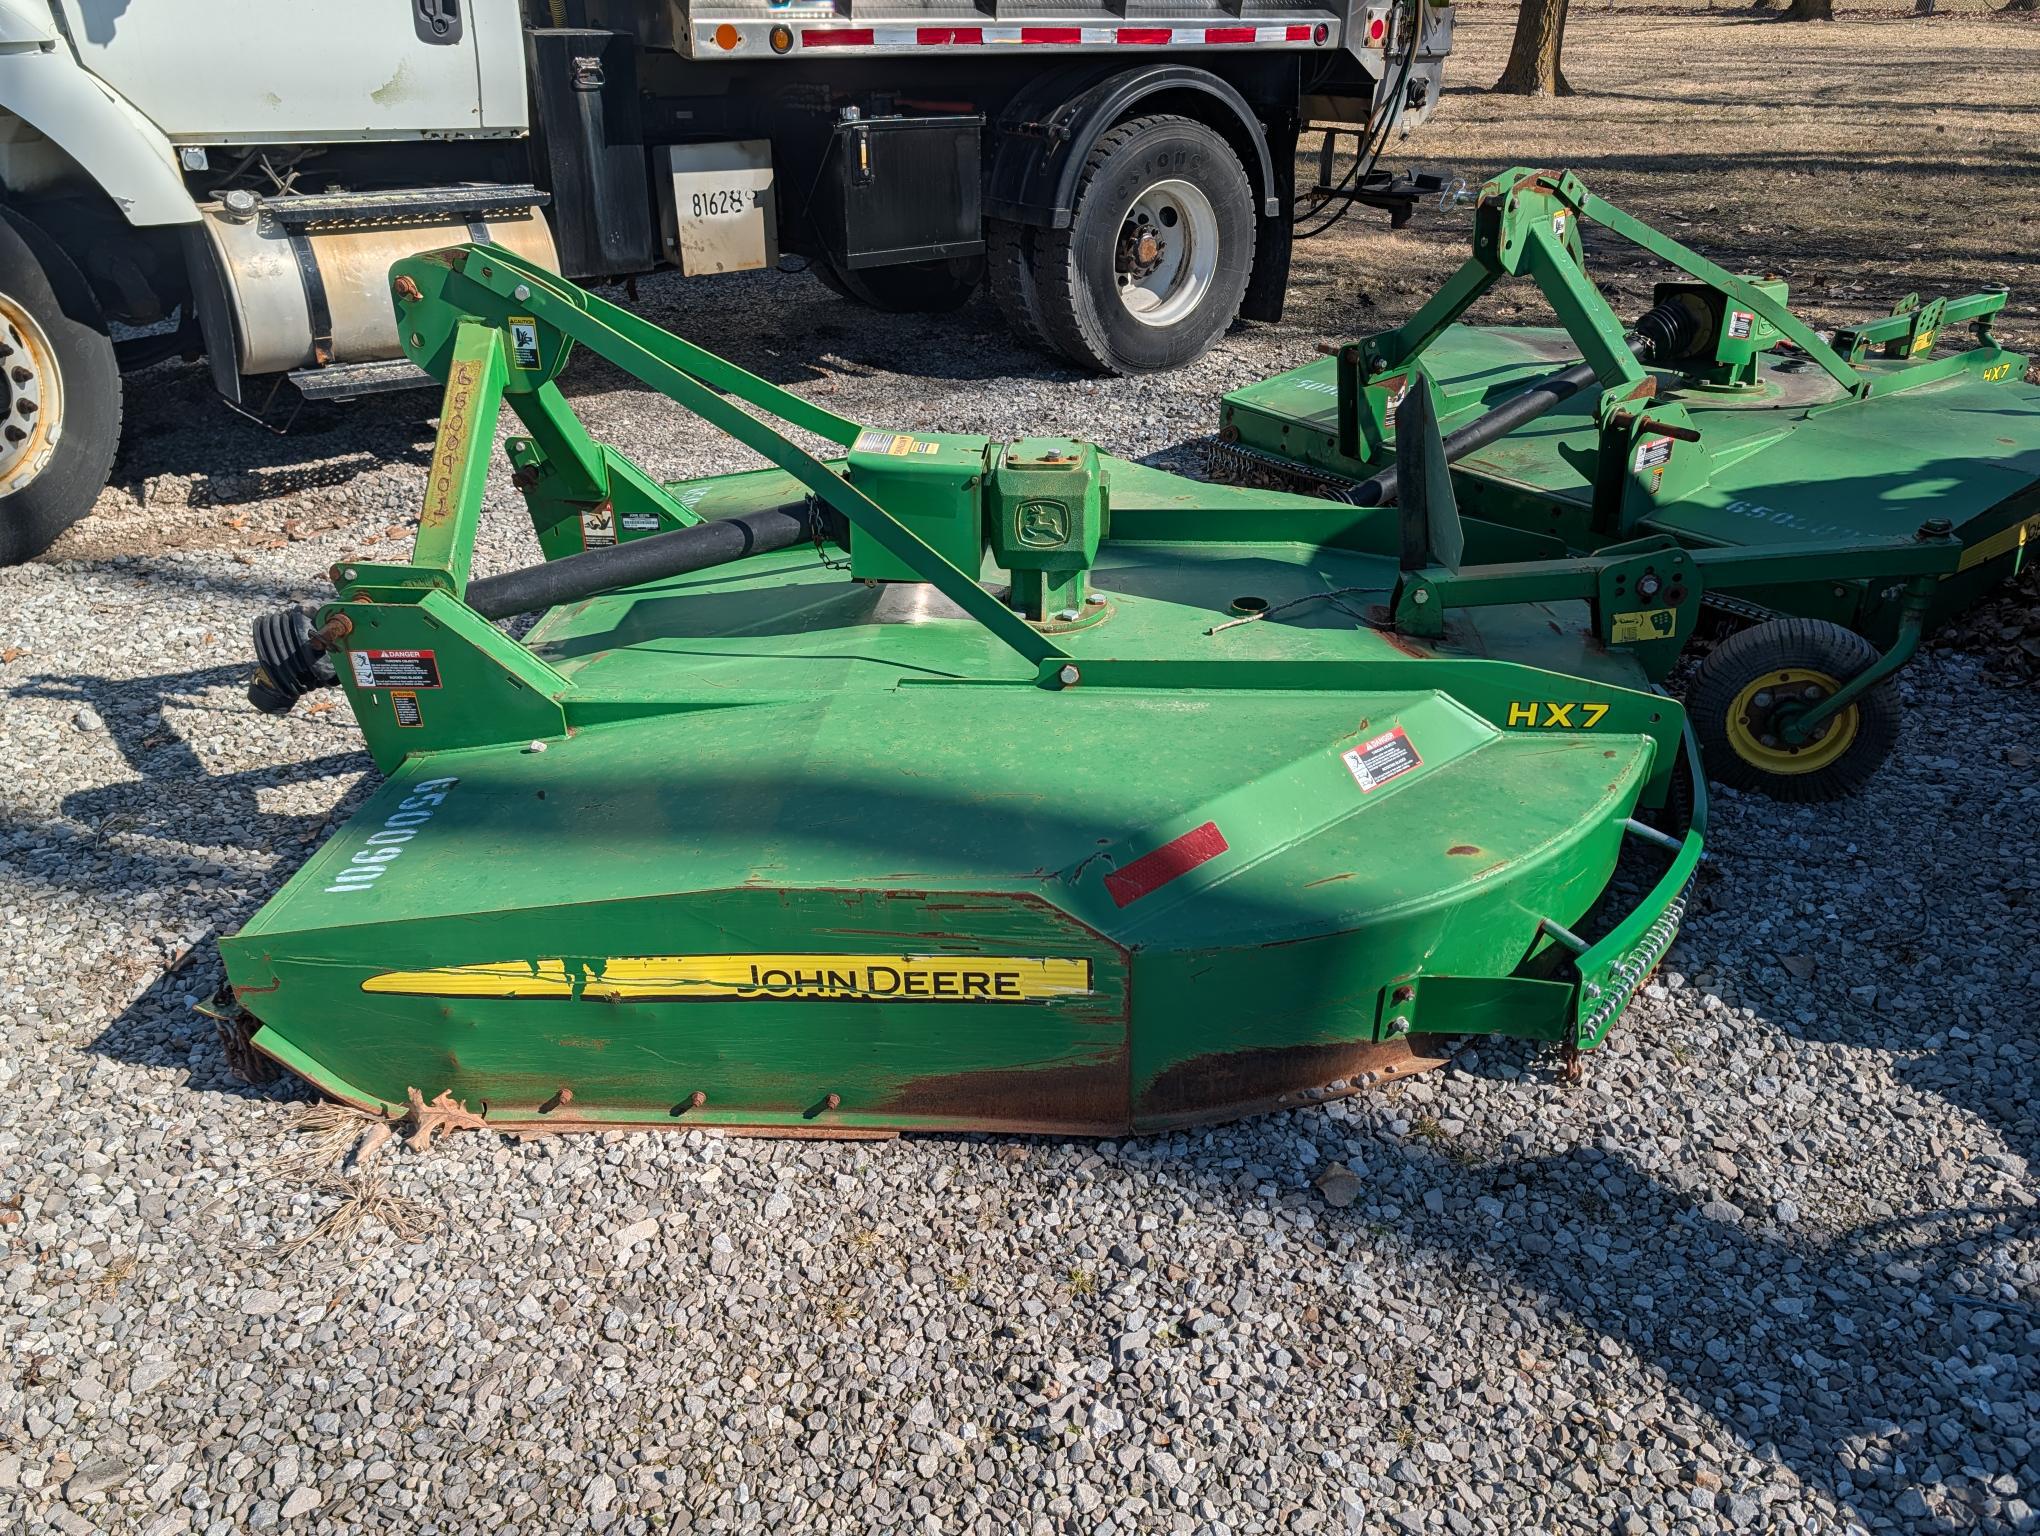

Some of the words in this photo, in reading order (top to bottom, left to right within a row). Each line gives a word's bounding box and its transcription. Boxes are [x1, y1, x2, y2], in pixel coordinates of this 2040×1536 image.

[1984, 363, 2011, 381] HX7
[1507, 702, 1611, 728] HX7
[738, 964, 857, 995] JOHN
[866, 966, 1021, 996] DEERE
